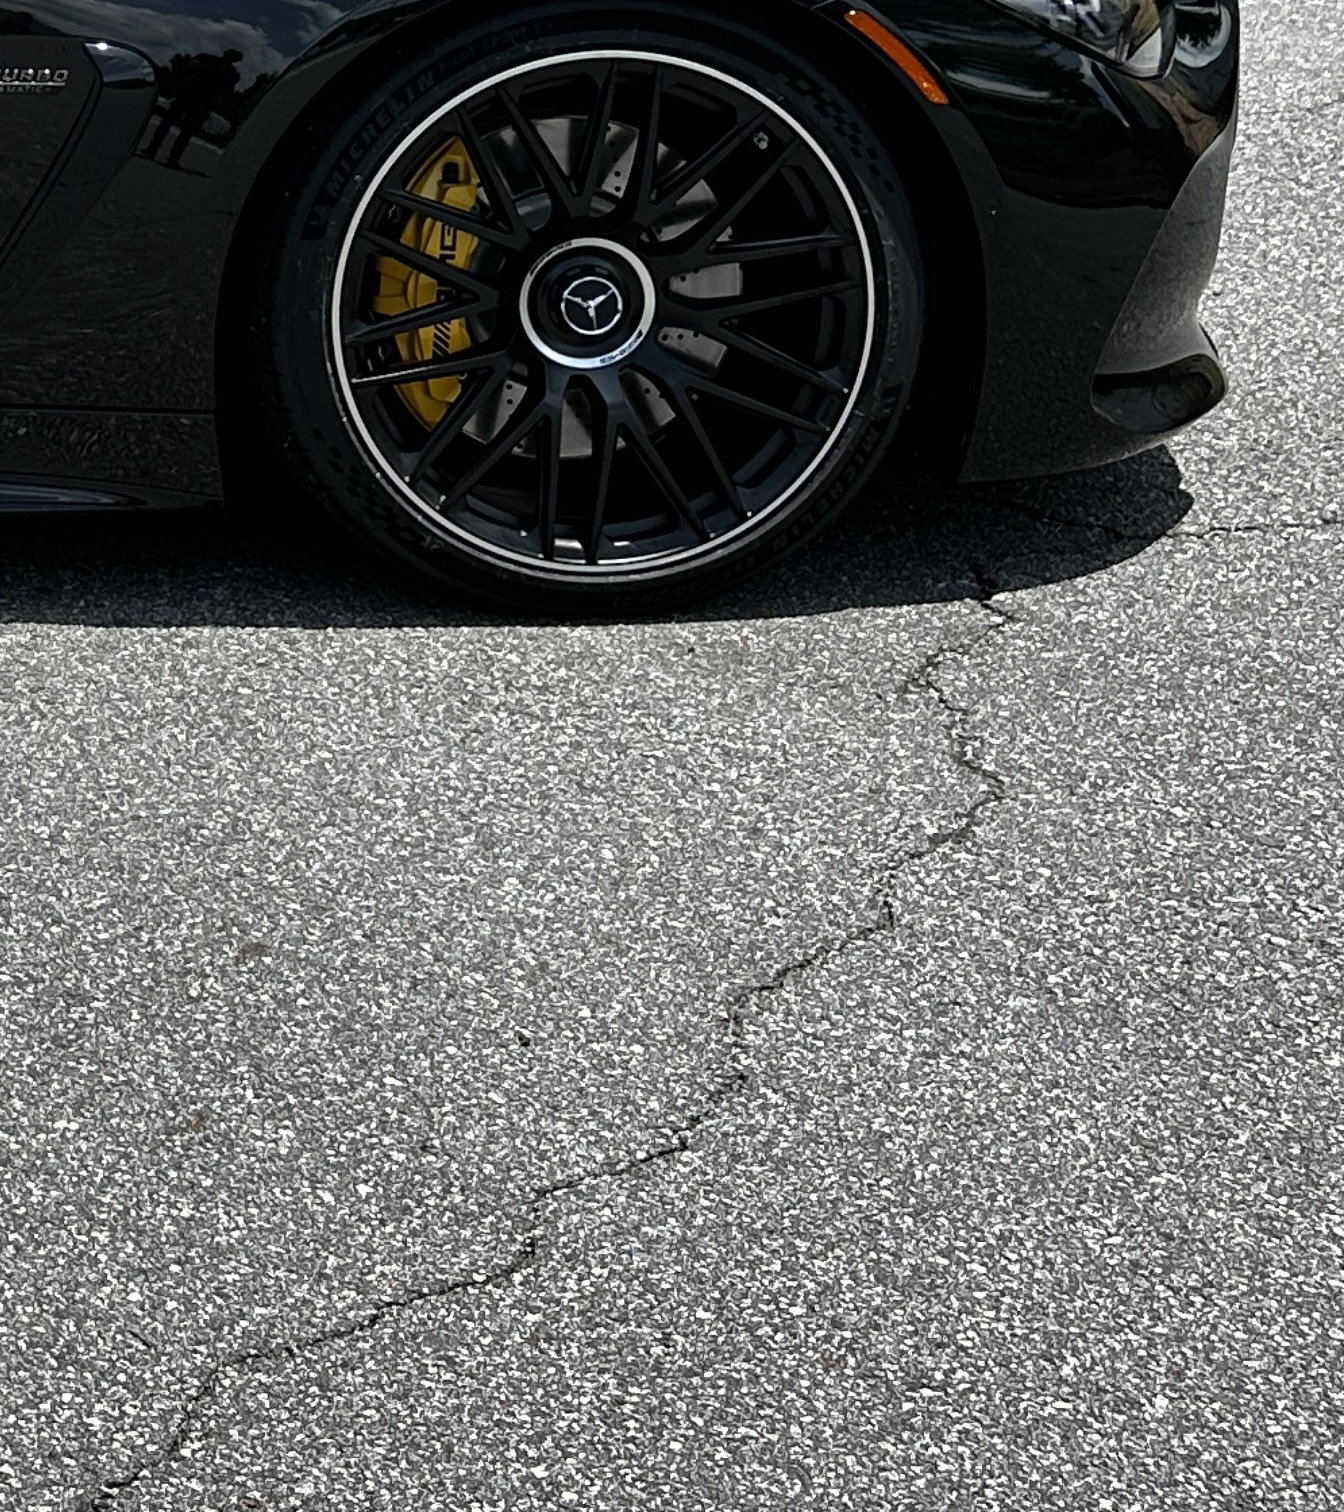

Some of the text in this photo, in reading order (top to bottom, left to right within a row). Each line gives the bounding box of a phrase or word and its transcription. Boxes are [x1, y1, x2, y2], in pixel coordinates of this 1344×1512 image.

[323, 67, 439, 199] MICHELIN
[434, 45, 478, 75] PILOT
[768, 425, 881, 555] MICHELIN
